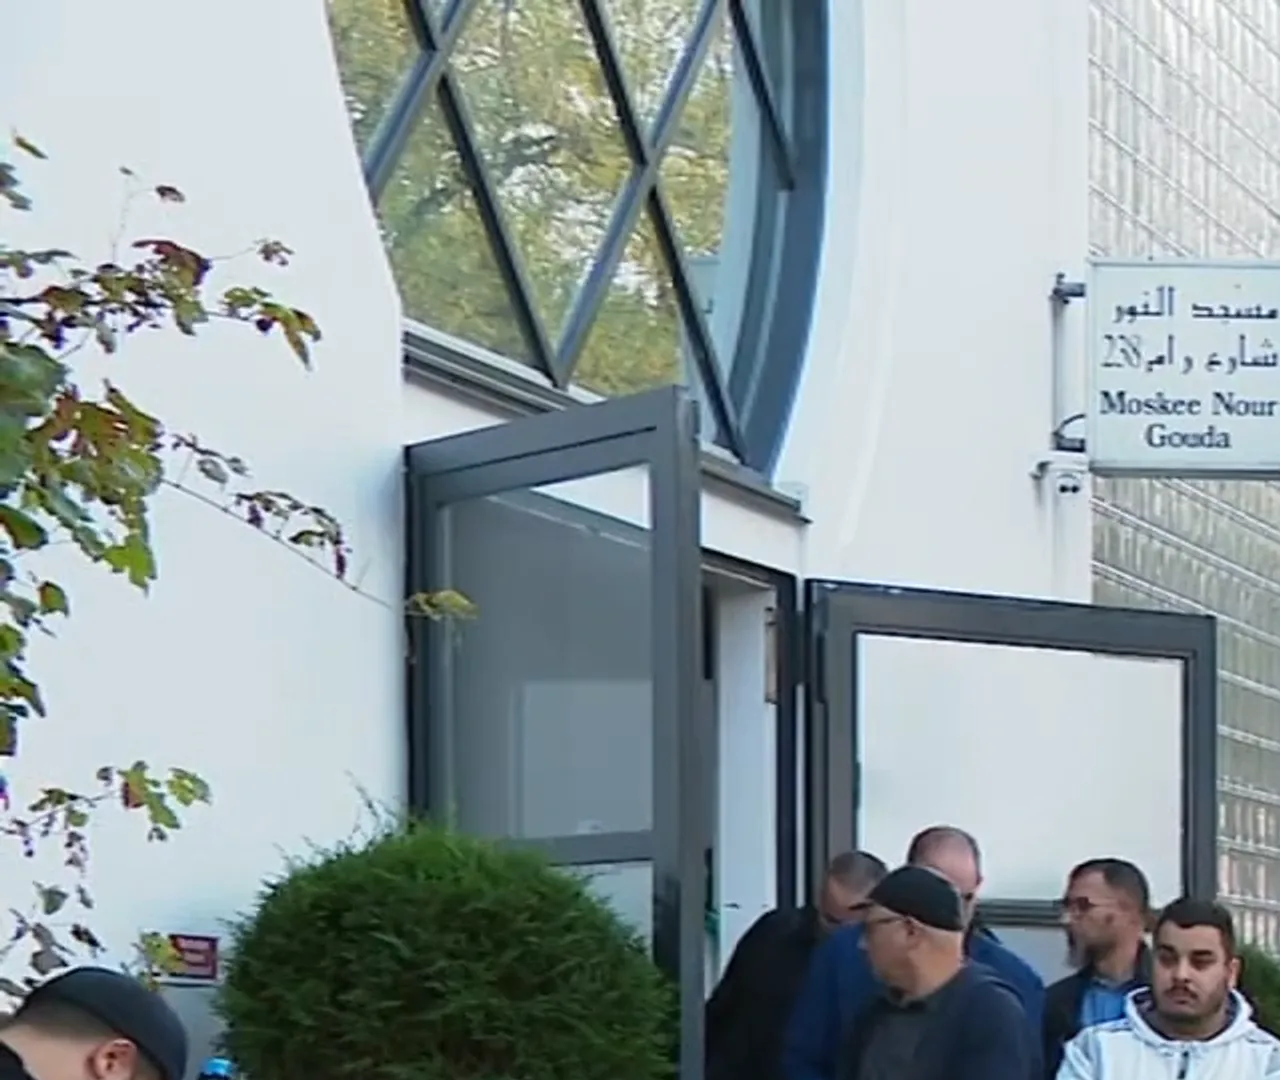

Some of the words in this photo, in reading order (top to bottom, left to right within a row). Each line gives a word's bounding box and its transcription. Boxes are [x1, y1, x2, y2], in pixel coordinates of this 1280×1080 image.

[1112, 285, 1175, 324] النور
[1099, 390, 1202, 417] Moskee
[1212, 390, 1279, 417] Nour
[1145, 423, 1232, 449] Gouda
